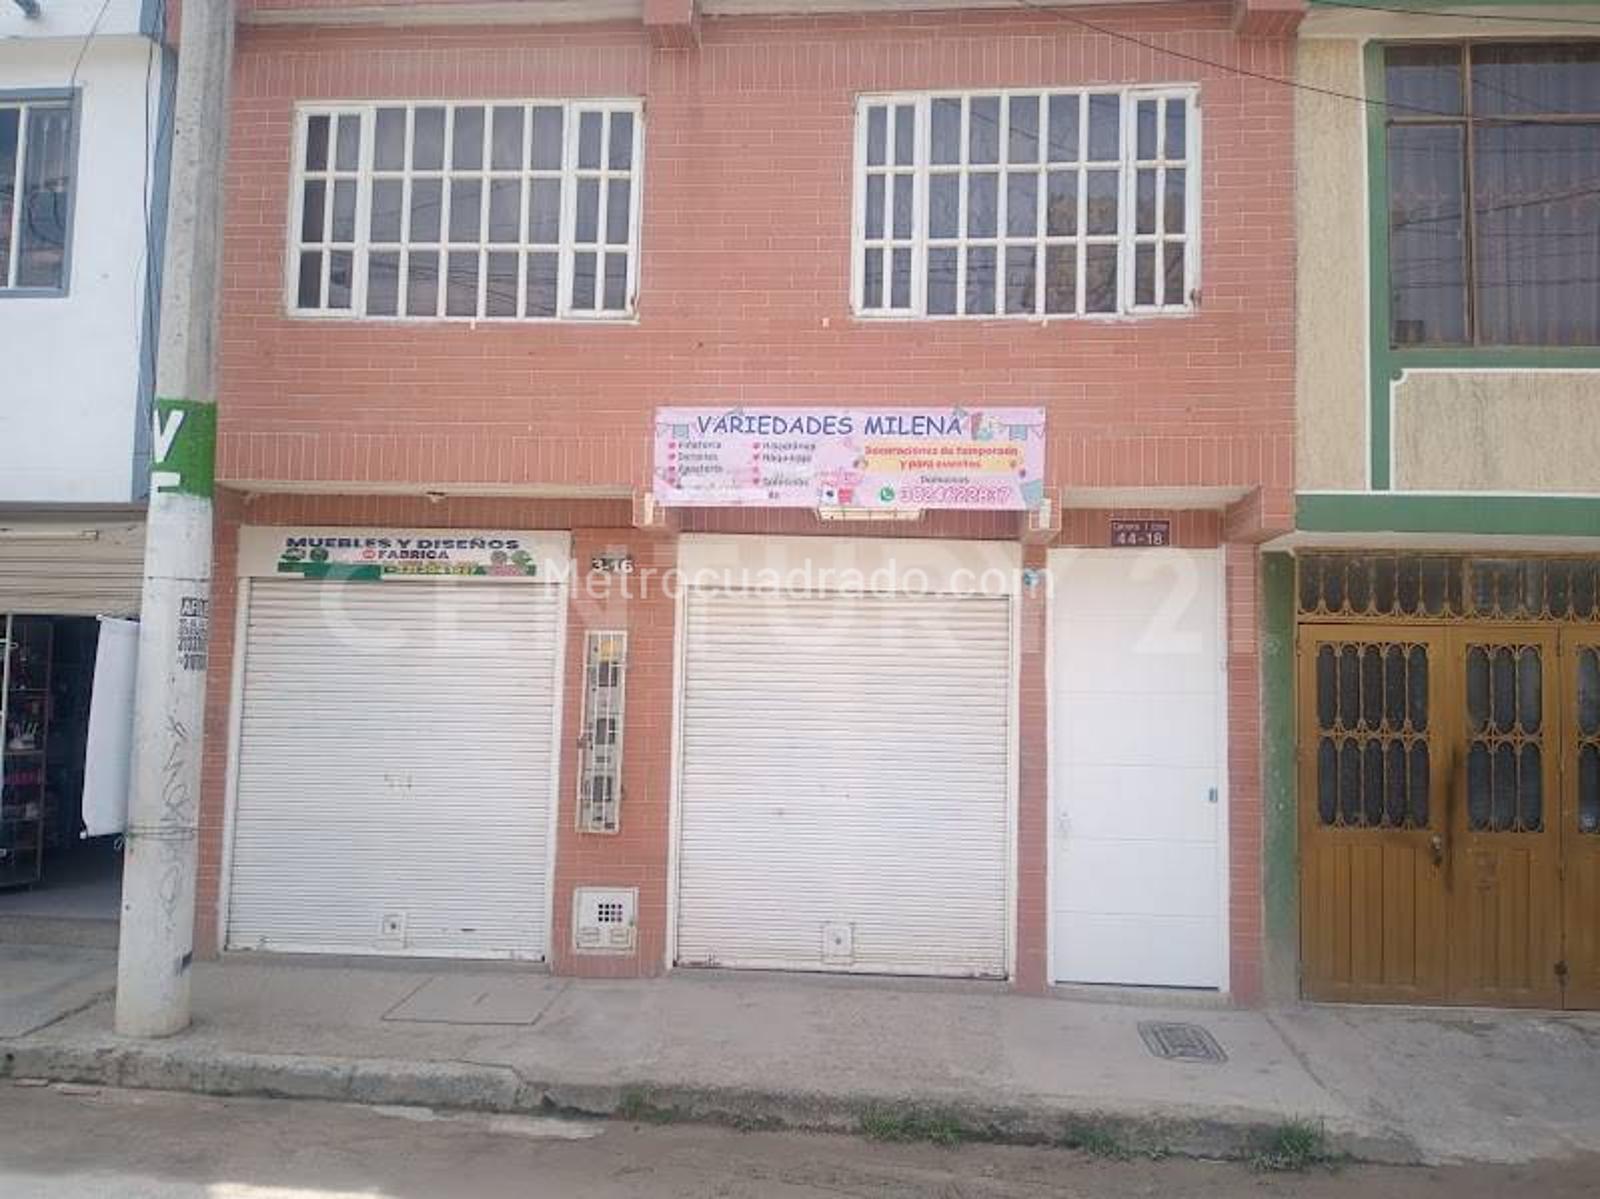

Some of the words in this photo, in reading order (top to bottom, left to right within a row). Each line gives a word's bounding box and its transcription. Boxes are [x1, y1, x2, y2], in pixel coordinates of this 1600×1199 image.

[697, 415, 853, 435] VARIEDADES
[863, 415, 962, 435] MILENA
[286, 537, 392, 549] MUEBLES
[396, 538, 411, 549] Y
[416, 536, 520, 550] DISEÑOS
[1116, 531, 1162, 545] 44-18
[377, 549, 450, 560] FABRICA
